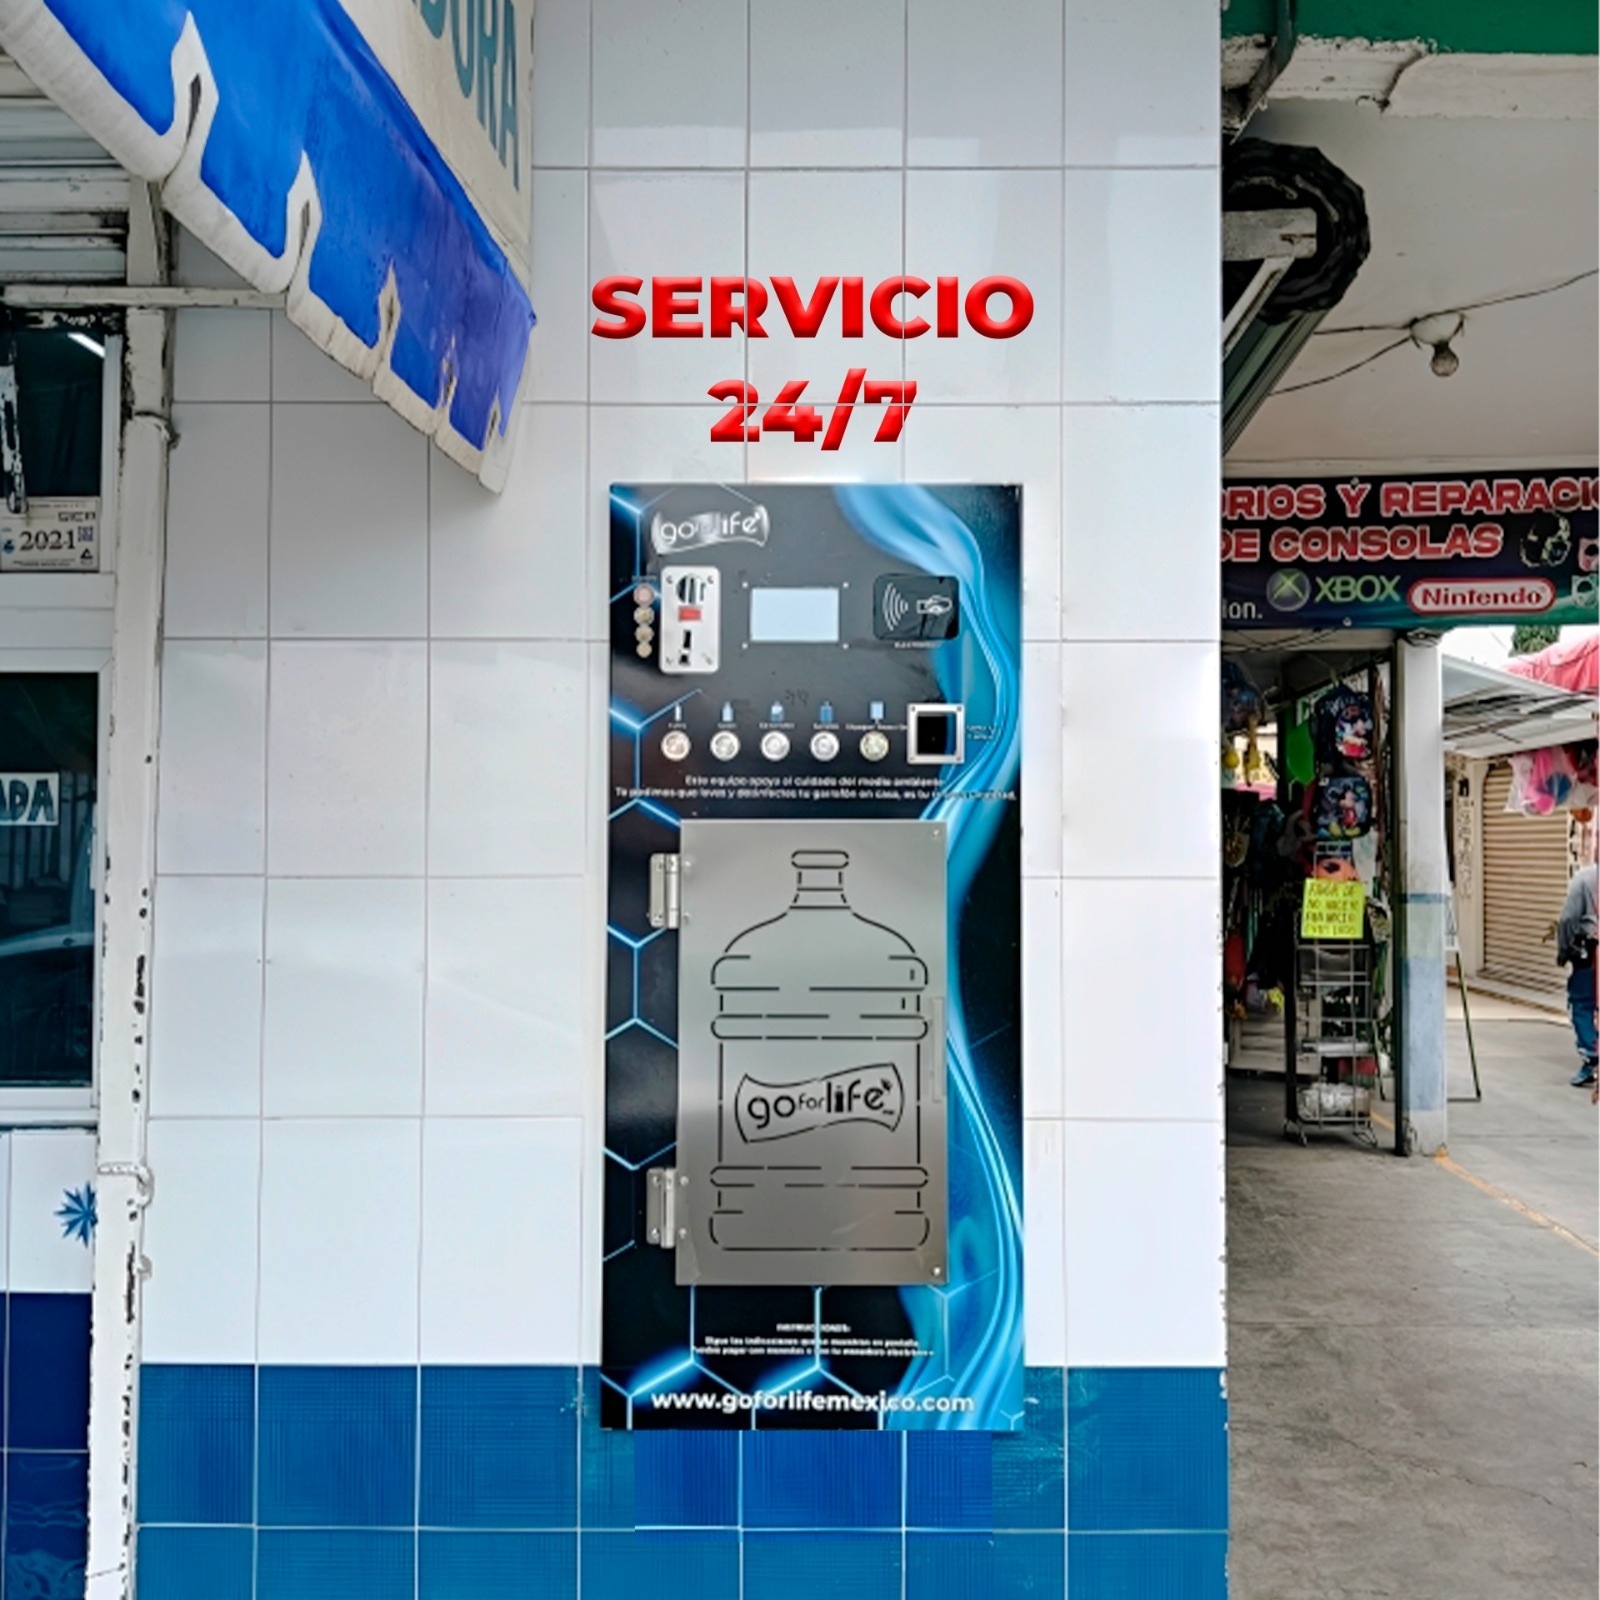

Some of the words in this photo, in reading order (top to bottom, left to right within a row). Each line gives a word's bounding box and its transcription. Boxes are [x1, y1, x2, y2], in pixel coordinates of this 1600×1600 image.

[1337, 482, 1370, 518] Y
[19, 528, 76, 551] 2021
[1270, 522, 1505, 562] CONSOLAS
[1315, 573, 1401, 603] XBOX
[1421, 586, 1545, 607] Nintendo
[651, 1390, 975, 1414] www.goforlifemexico.com
